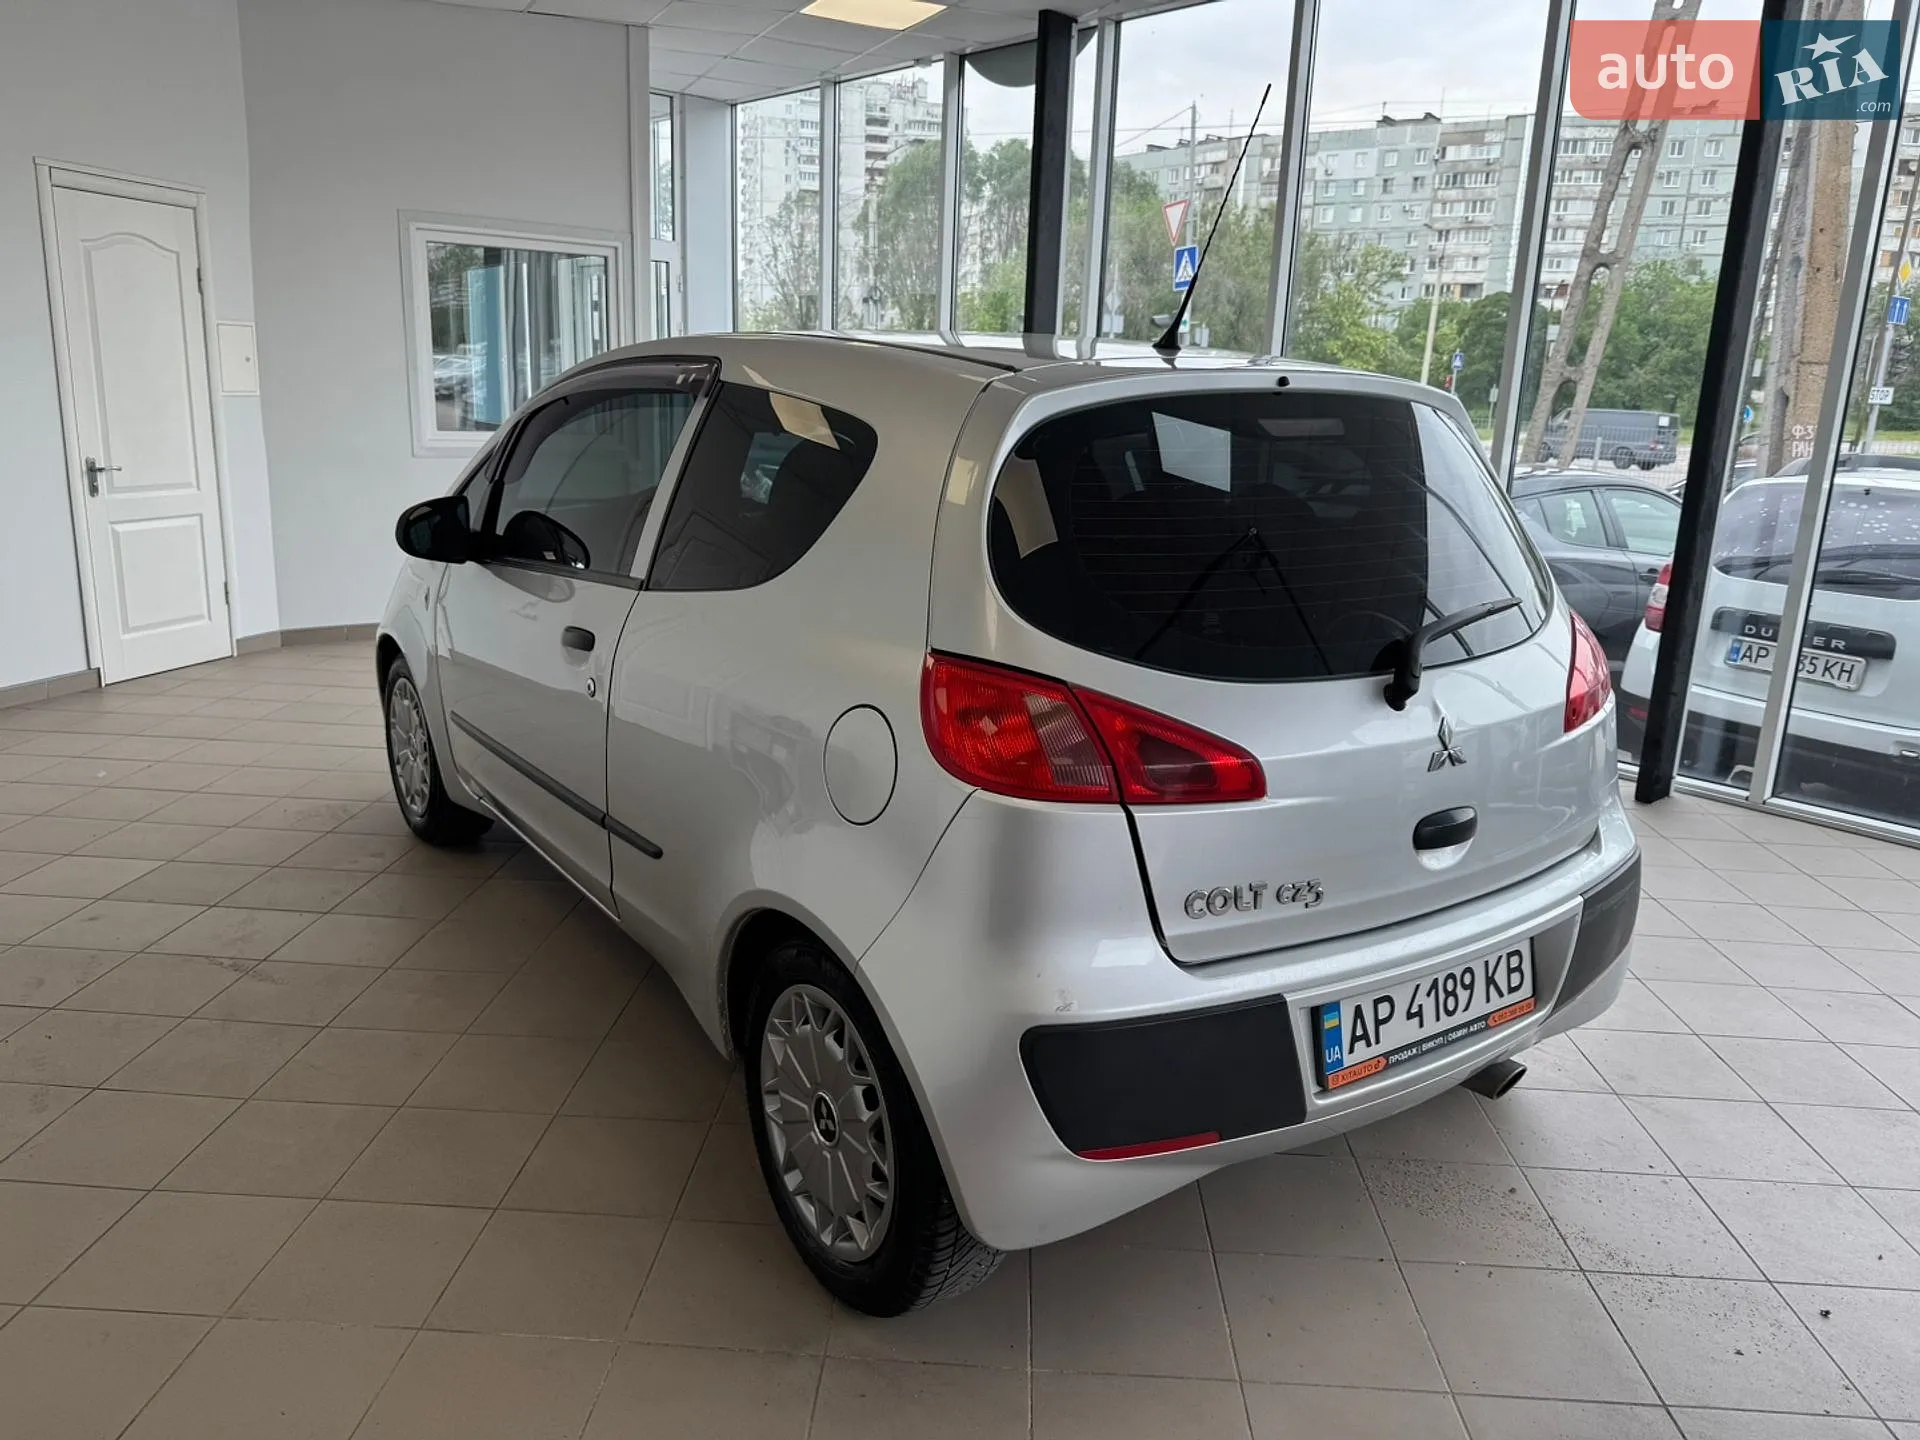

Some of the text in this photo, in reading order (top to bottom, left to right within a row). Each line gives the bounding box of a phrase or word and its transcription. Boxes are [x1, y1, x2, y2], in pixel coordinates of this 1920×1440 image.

[1744, 625, 1847, 650] DUER
[1740, 644, 1769, 663] AP
[1822, 659, 1855, 682] KH
[1184, 881, 1268, 919] COLT
[1348, 949, 1525, 1055] AP 4189 KB
[1325, 1045, 1341, 1063] UA
